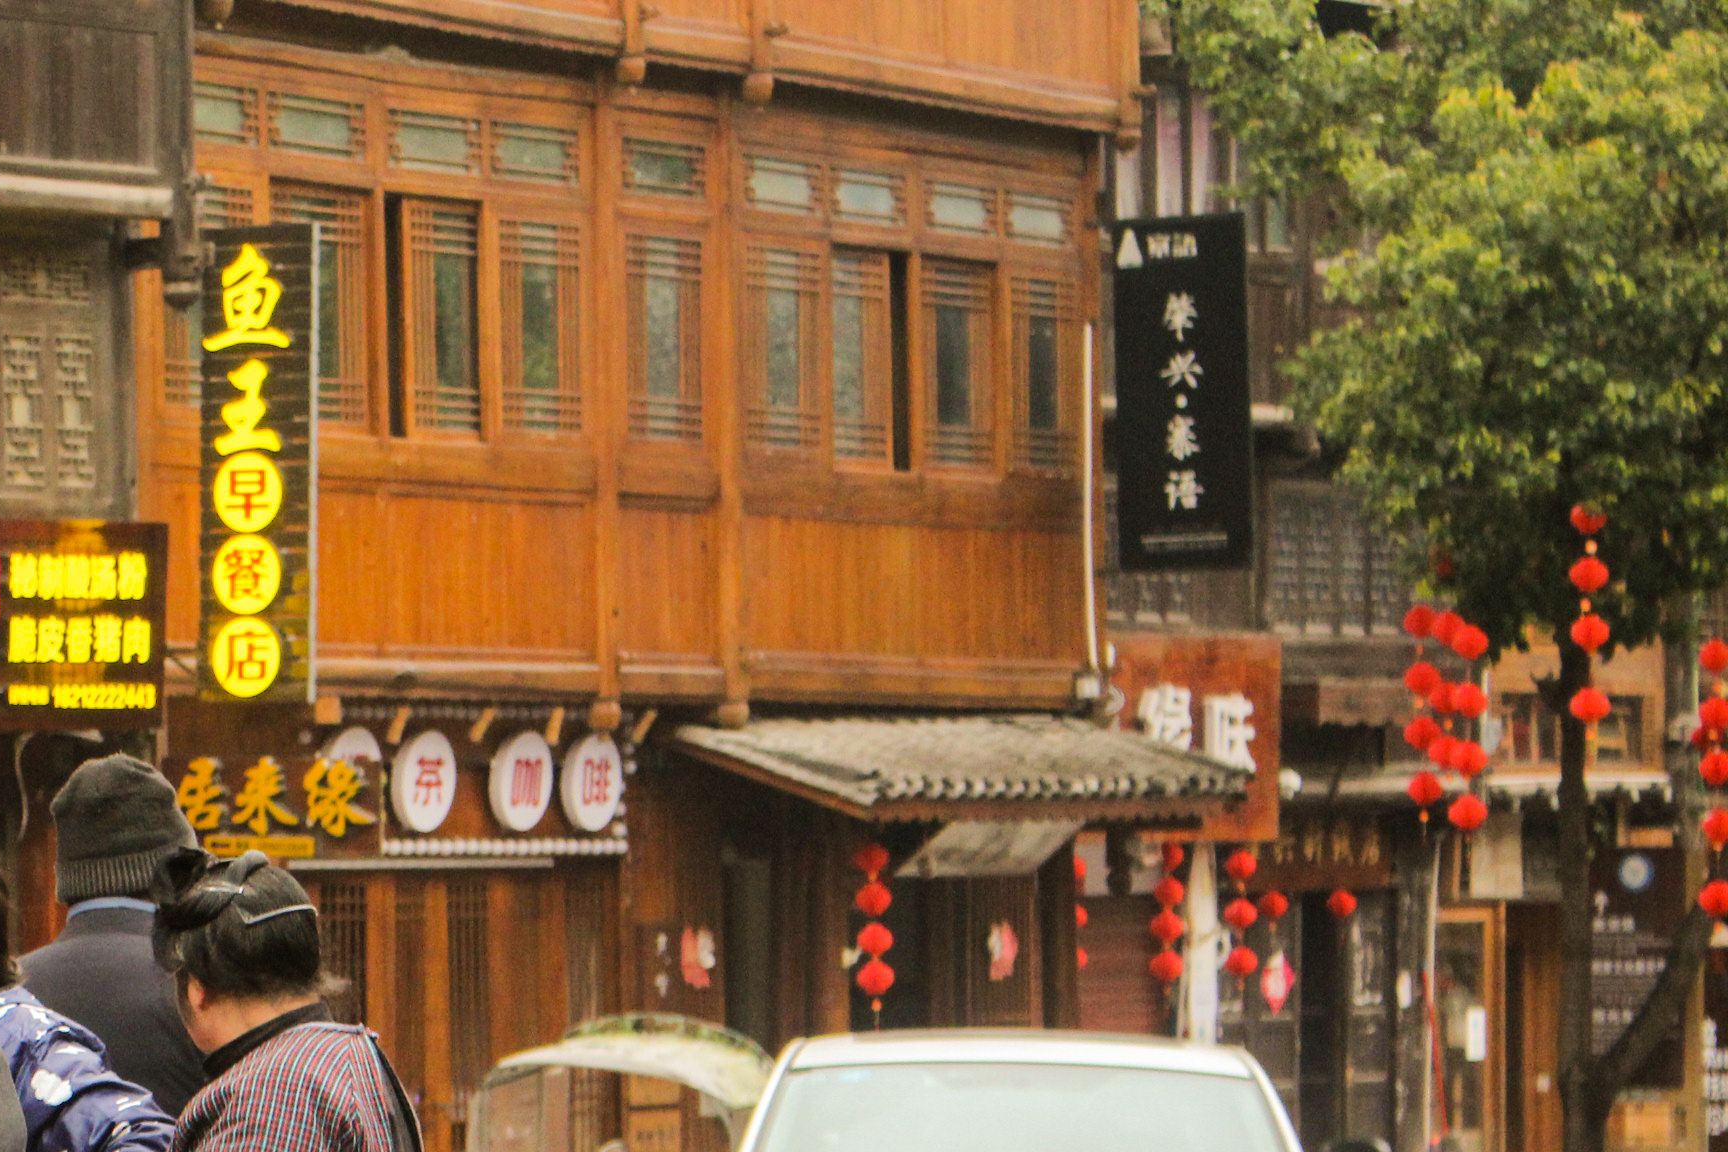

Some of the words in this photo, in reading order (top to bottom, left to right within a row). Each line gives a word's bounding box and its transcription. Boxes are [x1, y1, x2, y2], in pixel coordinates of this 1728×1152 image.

[203, 243, 291, 684] 鱼王早餐店
[511, 758, 610, 807] 咖啡
